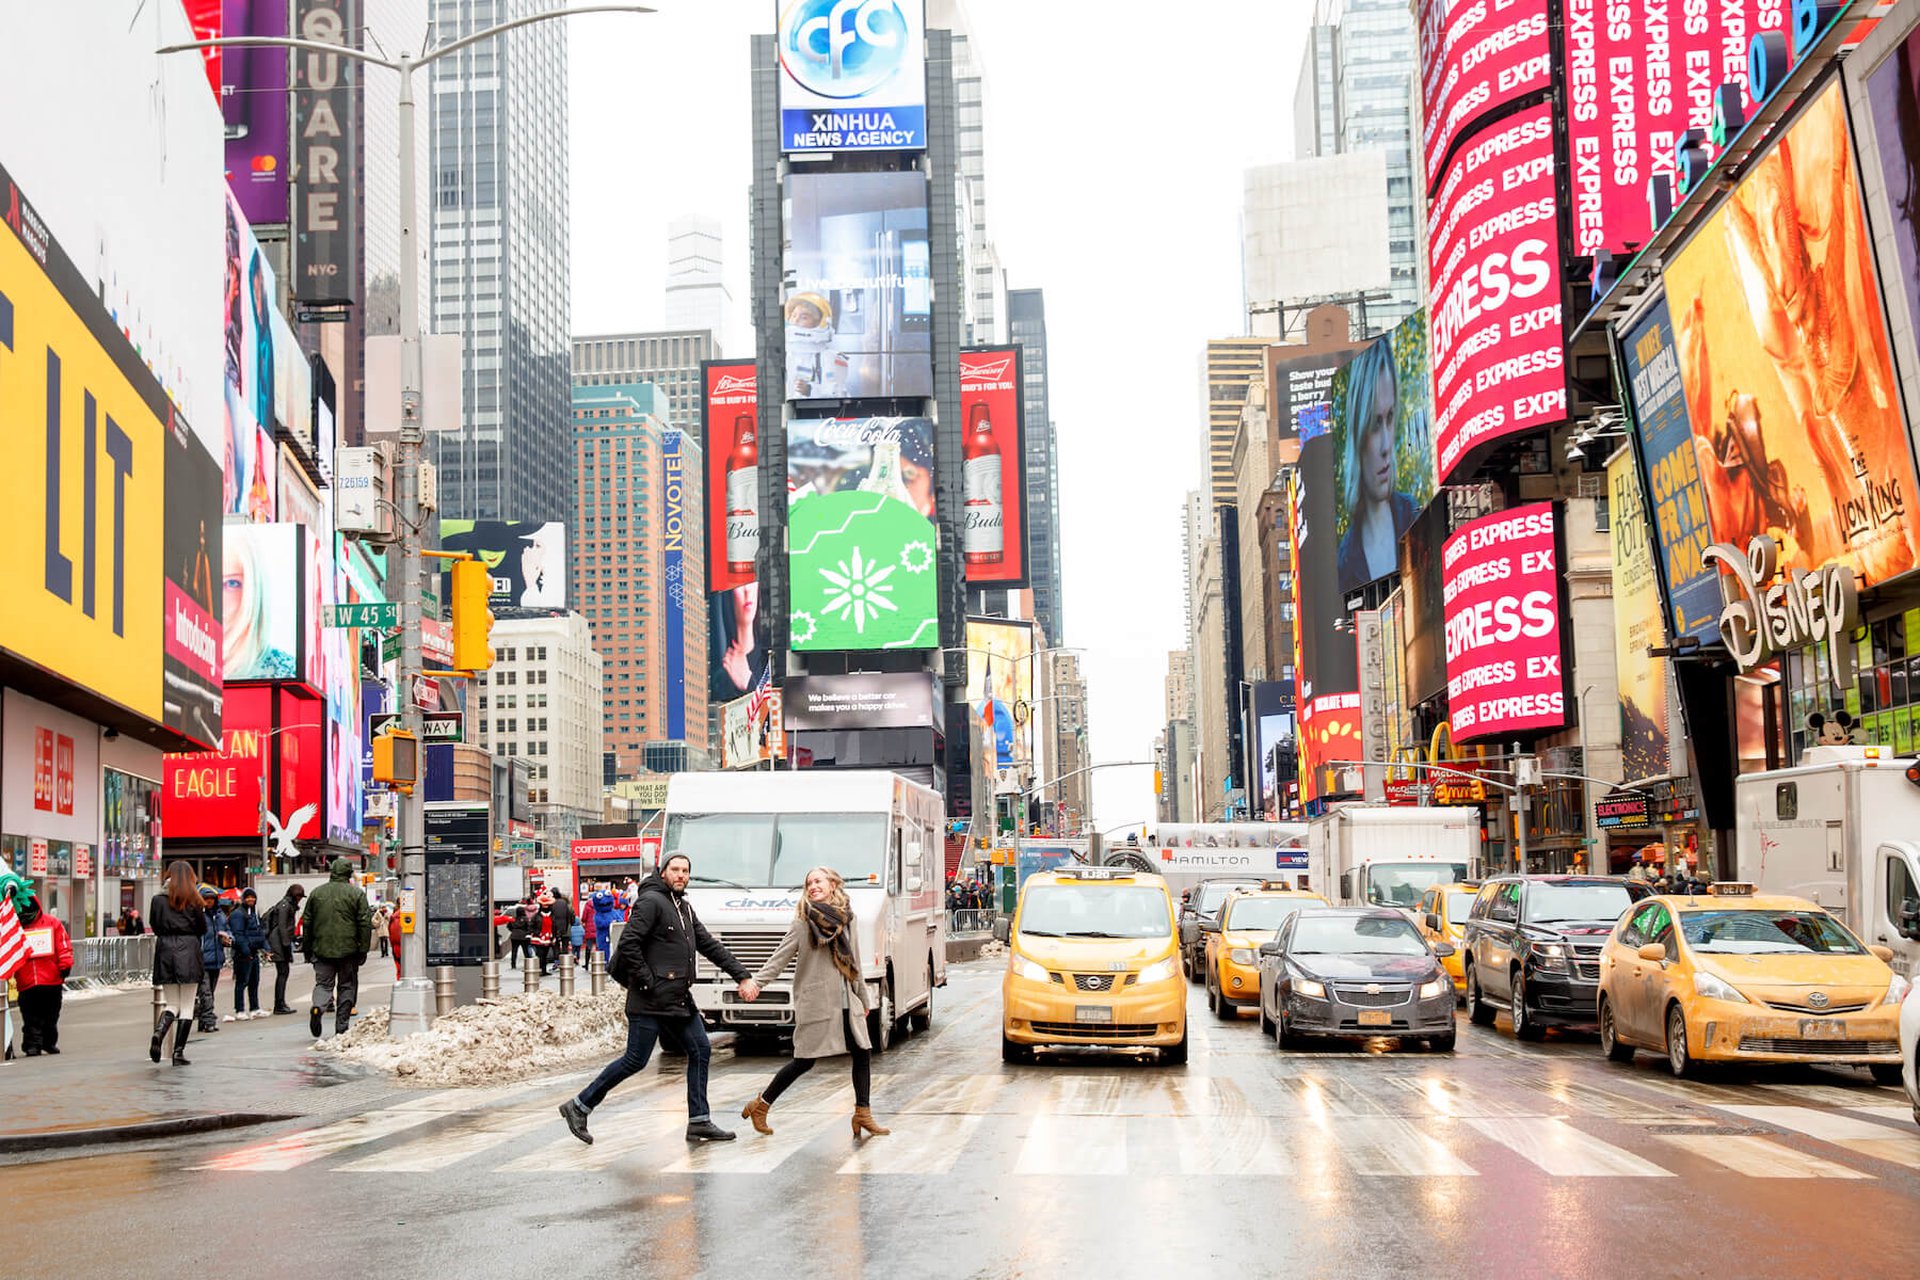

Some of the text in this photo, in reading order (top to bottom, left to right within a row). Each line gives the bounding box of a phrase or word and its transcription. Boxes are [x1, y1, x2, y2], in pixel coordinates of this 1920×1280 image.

[1461, 13, 1547, 74] EXPRESS
[1644, 0, 1673, 116] XPRESS
[303, 0, 344, 231] QUARE
[812, 113, 896, 131] XINHUA
[1609, 56, 1638, 186] EXPRESS
[794, 130, 915, 147] NEWS AGENCY
[1465, 116, 1551, 173] EXPRESS
[1469, 197, 1556, 250] EXPRESS
[308, 264, 338, 277] NYC
[1433, 239, 1550, 369] EXPRESS
[1289, 367, 1338, 381] Show your
[1290, 381, 1313, 392] taste
[1476, 347, 1563, 393] EXPRESS
[1298, 390, 1325, 401] berry
[814, 416, 902, 447] Coca-Cola
[1460, 405, 1505, 449] EXPRESS
[1652, 440, 1699, 503] COME
[45, 345, 133, 639] LIT
[664, 447, 682, 551] NOVOTEL
[1835, 496, 1868, 545] LION
[1865, 478, 1903, 530] KING
[1471, 511, 1554, 550] EXPRESS
[1669, 525, 1711, 590] AWAY
[1457, 558, 1511, 595] EXPRESS
[339, 605, 396, 625] W 45 St
[1445, 590, 1555, 664] EXPRESS
[173, 597, 217, 677] Introducing
[1366, 623, 1385, 762] PALACE
[1462, 660, 1517, 693] EXPRESS
[808, 694, 822, 702] We
[823, 692, 850, 702] believe
[858, 692, 882, 701] better
[808, 703, 835, 712] makes
[836, 703, 850, 713] you
[858, 702, 883, 713] happy
[1479, 692, 1565, 722] EXPRESS
[423, 722, 450, 735] WAY
[175, 768, 236, 799] EAGLE
[633, 784, 652, 792] WHAT
[1597, 801, 1645, 817] ELECTRONICS
[574, 844, 614, 854] COFFEED
[1167, 855, 1250, 865] HAMILTON
